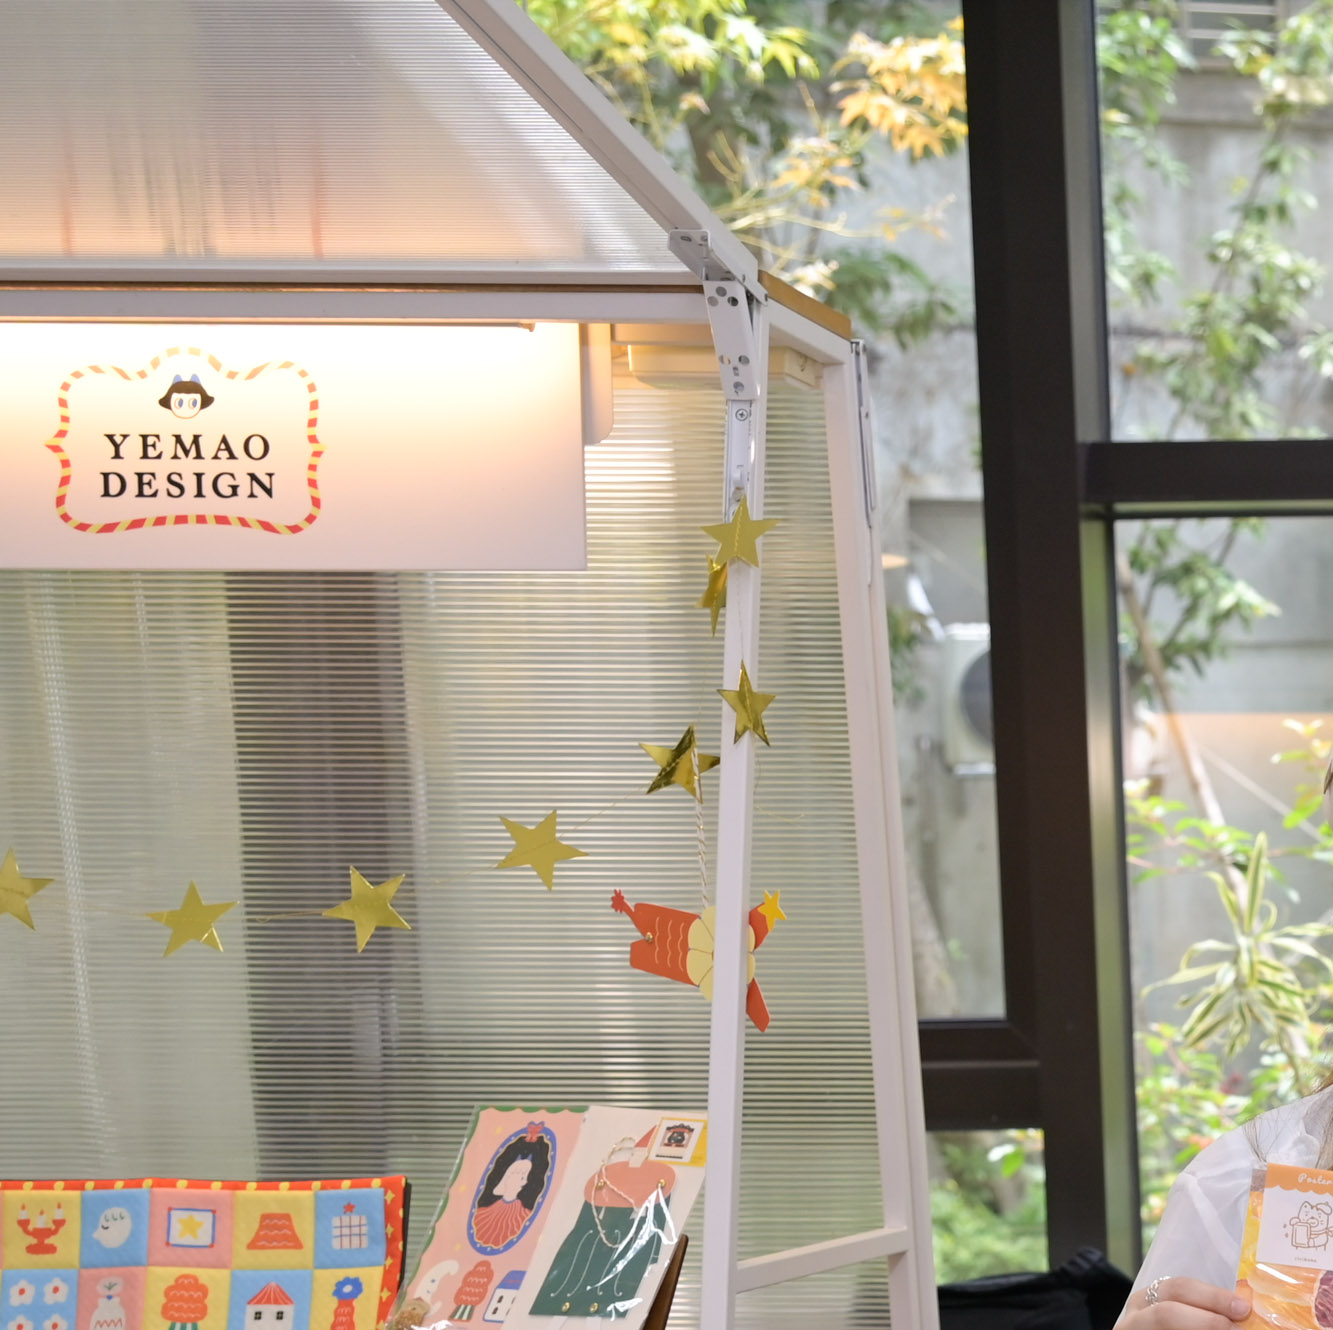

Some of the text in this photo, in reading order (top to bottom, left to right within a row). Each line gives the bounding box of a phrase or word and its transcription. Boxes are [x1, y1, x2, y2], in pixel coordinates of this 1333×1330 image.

[106, 435, 270, 461] YEMAO
[102, 473, 275, 499] DESIGN
[1297, 1173, 1333, 1185] Poster
